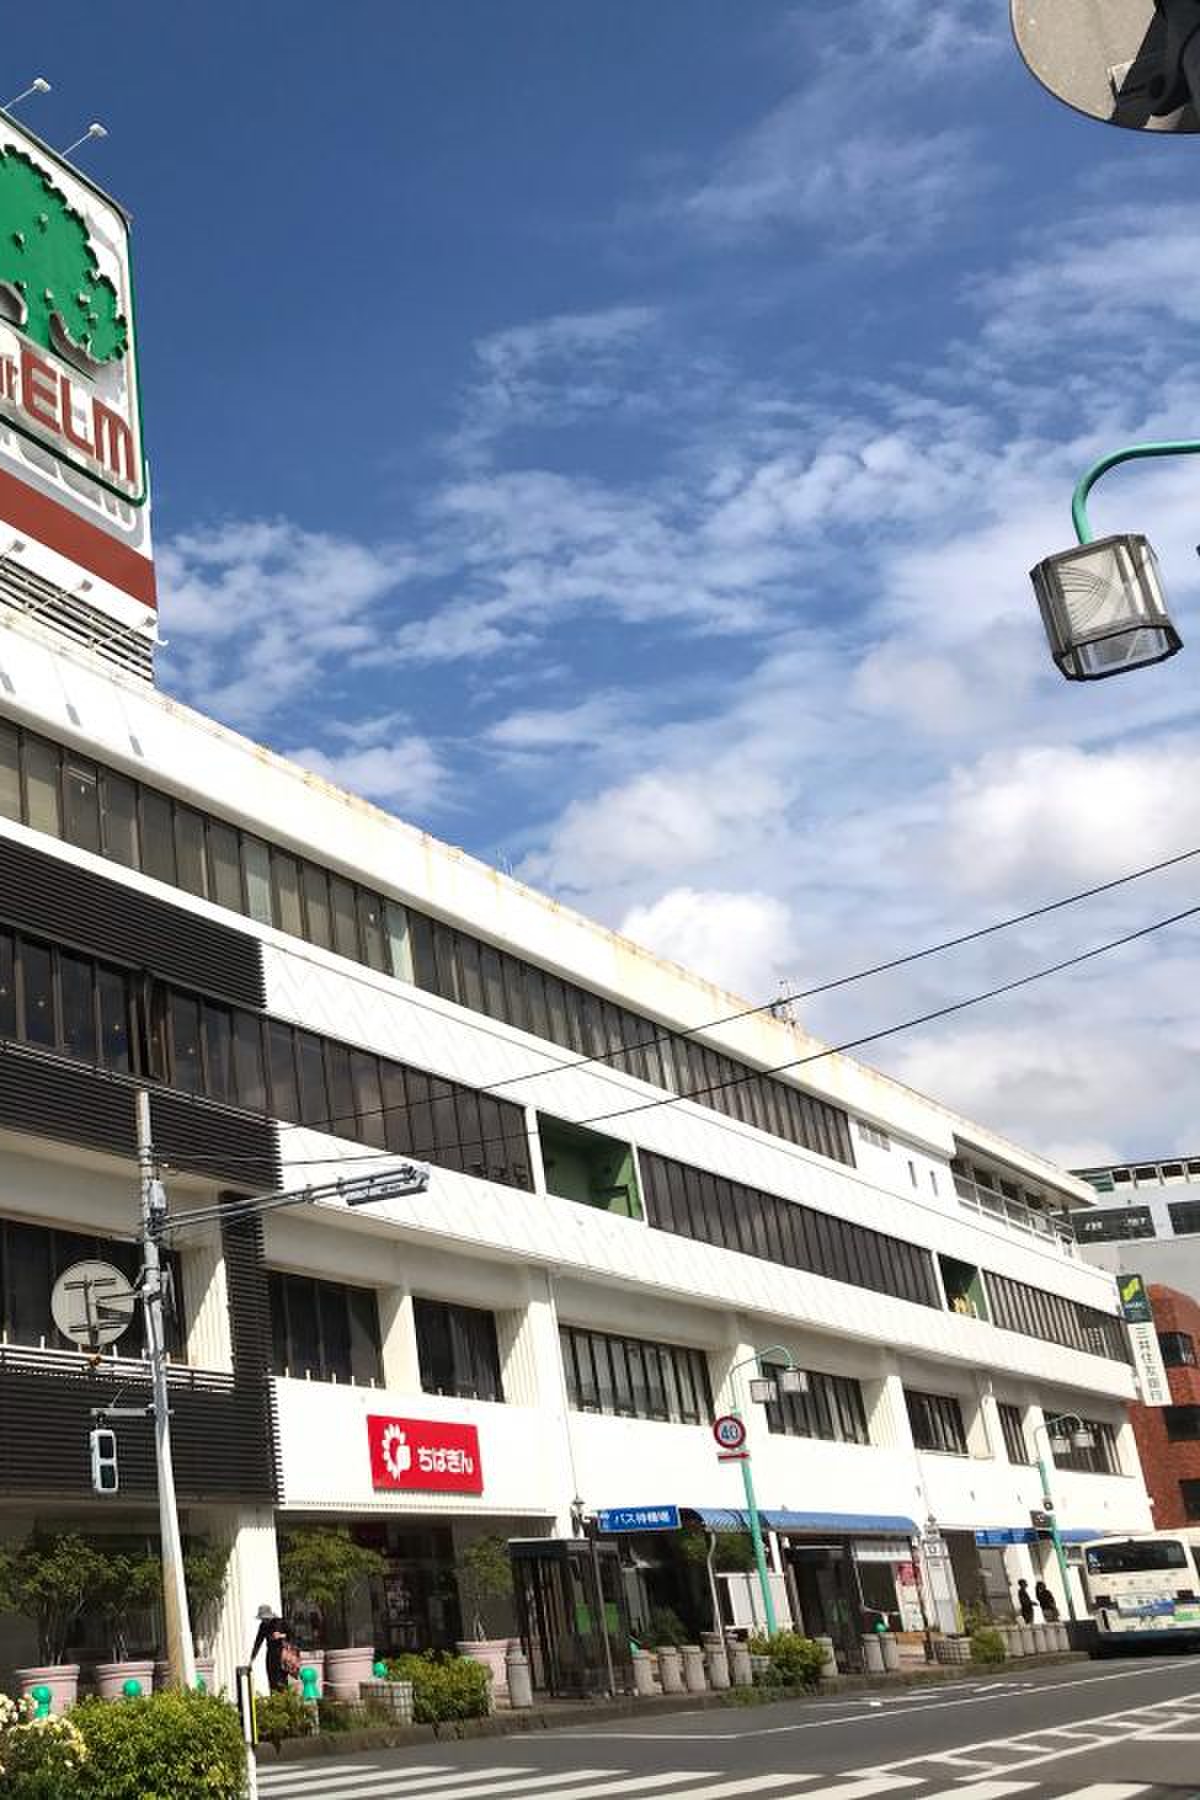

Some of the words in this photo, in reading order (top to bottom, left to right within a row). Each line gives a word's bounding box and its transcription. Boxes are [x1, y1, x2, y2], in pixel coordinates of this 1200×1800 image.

[721, 1424, 738, 1440] 40
[417, 1446, 473, 1475] ちばぎん
